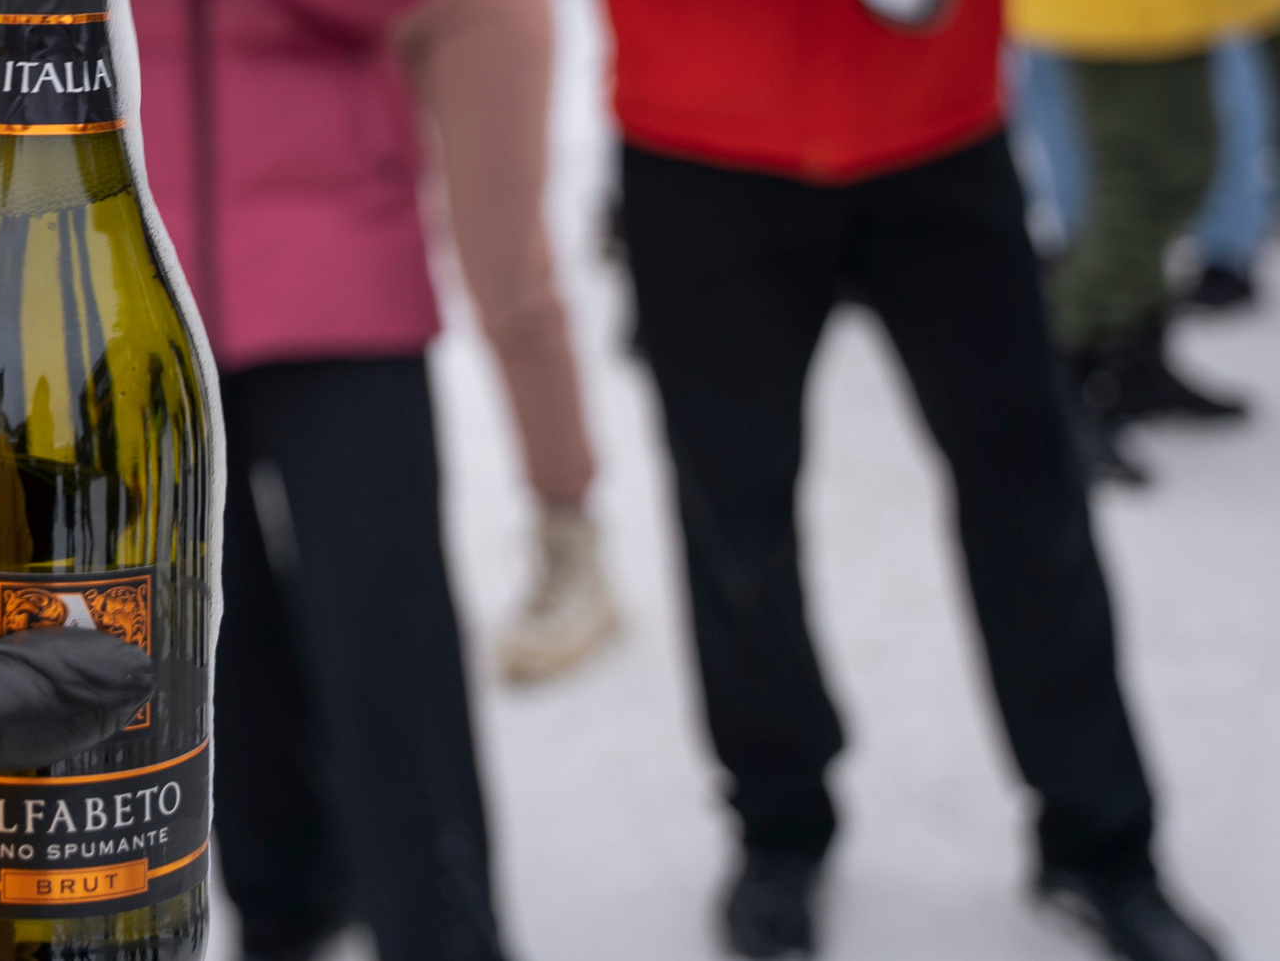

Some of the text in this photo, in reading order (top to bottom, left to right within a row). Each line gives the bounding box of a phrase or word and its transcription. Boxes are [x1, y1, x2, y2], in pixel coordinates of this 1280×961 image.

[2, 58, 113, 94] ITALIA
[46, 827, 169, 860] SPUMANTE
[36, 873, 119, 896] BRUT
